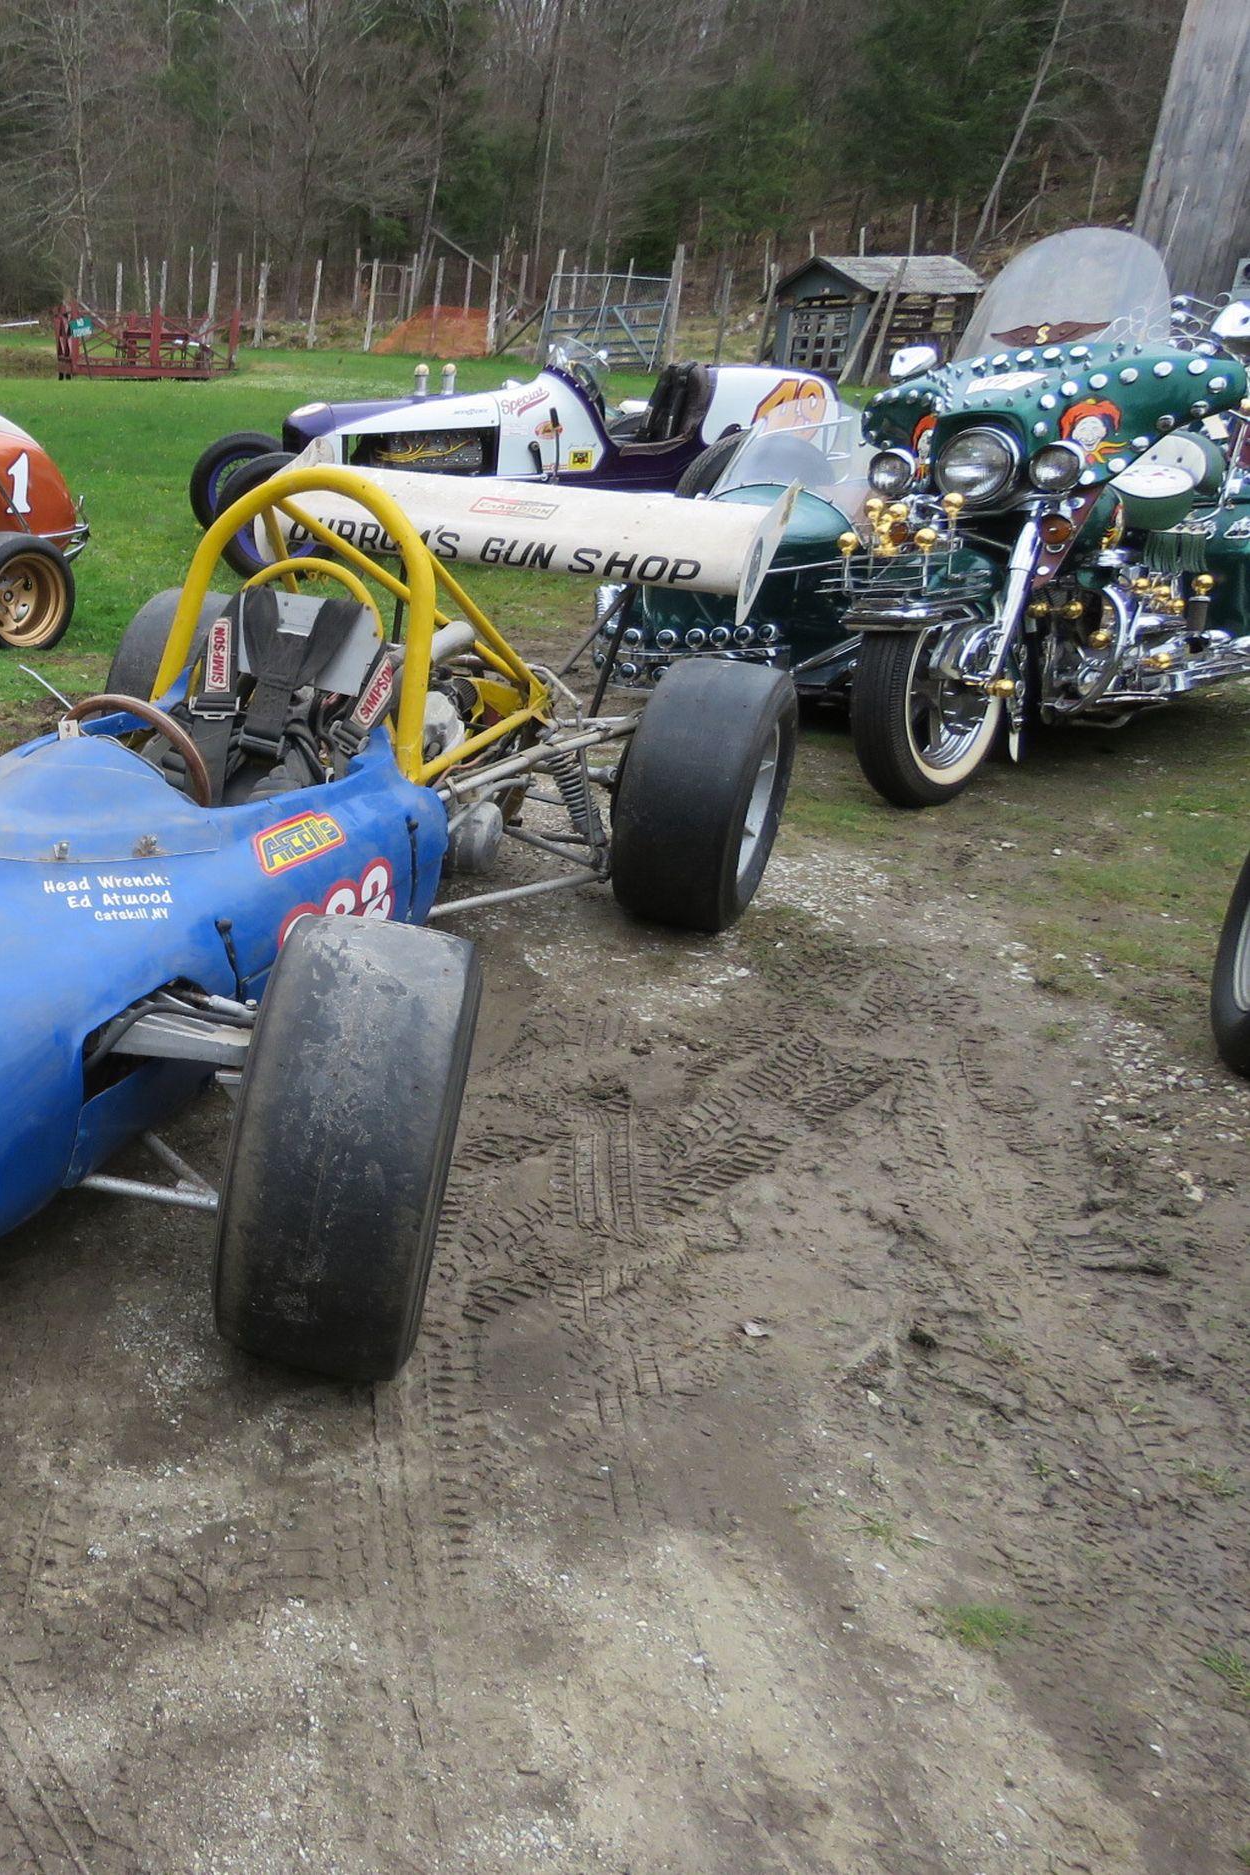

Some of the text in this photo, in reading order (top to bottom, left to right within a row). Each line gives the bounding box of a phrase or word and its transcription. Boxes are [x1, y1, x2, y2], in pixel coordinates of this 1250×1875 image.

[1034, 325, 1050, 345] S
[750, 378, 828, 441] 49
[5, 451, 32, 514] 1
[478, 536, 558, 570] GUN
[567, 547, 702, 584] SHOP
[210, 625, 227, 684] SIMPSON
[359, 662, 395, 720] SIMPSON
[43, 873, 172, 894] Head Wrench:
[67, 890, 174, 909] Ed Atwood
[94, 907, 148, 922] Catskill
